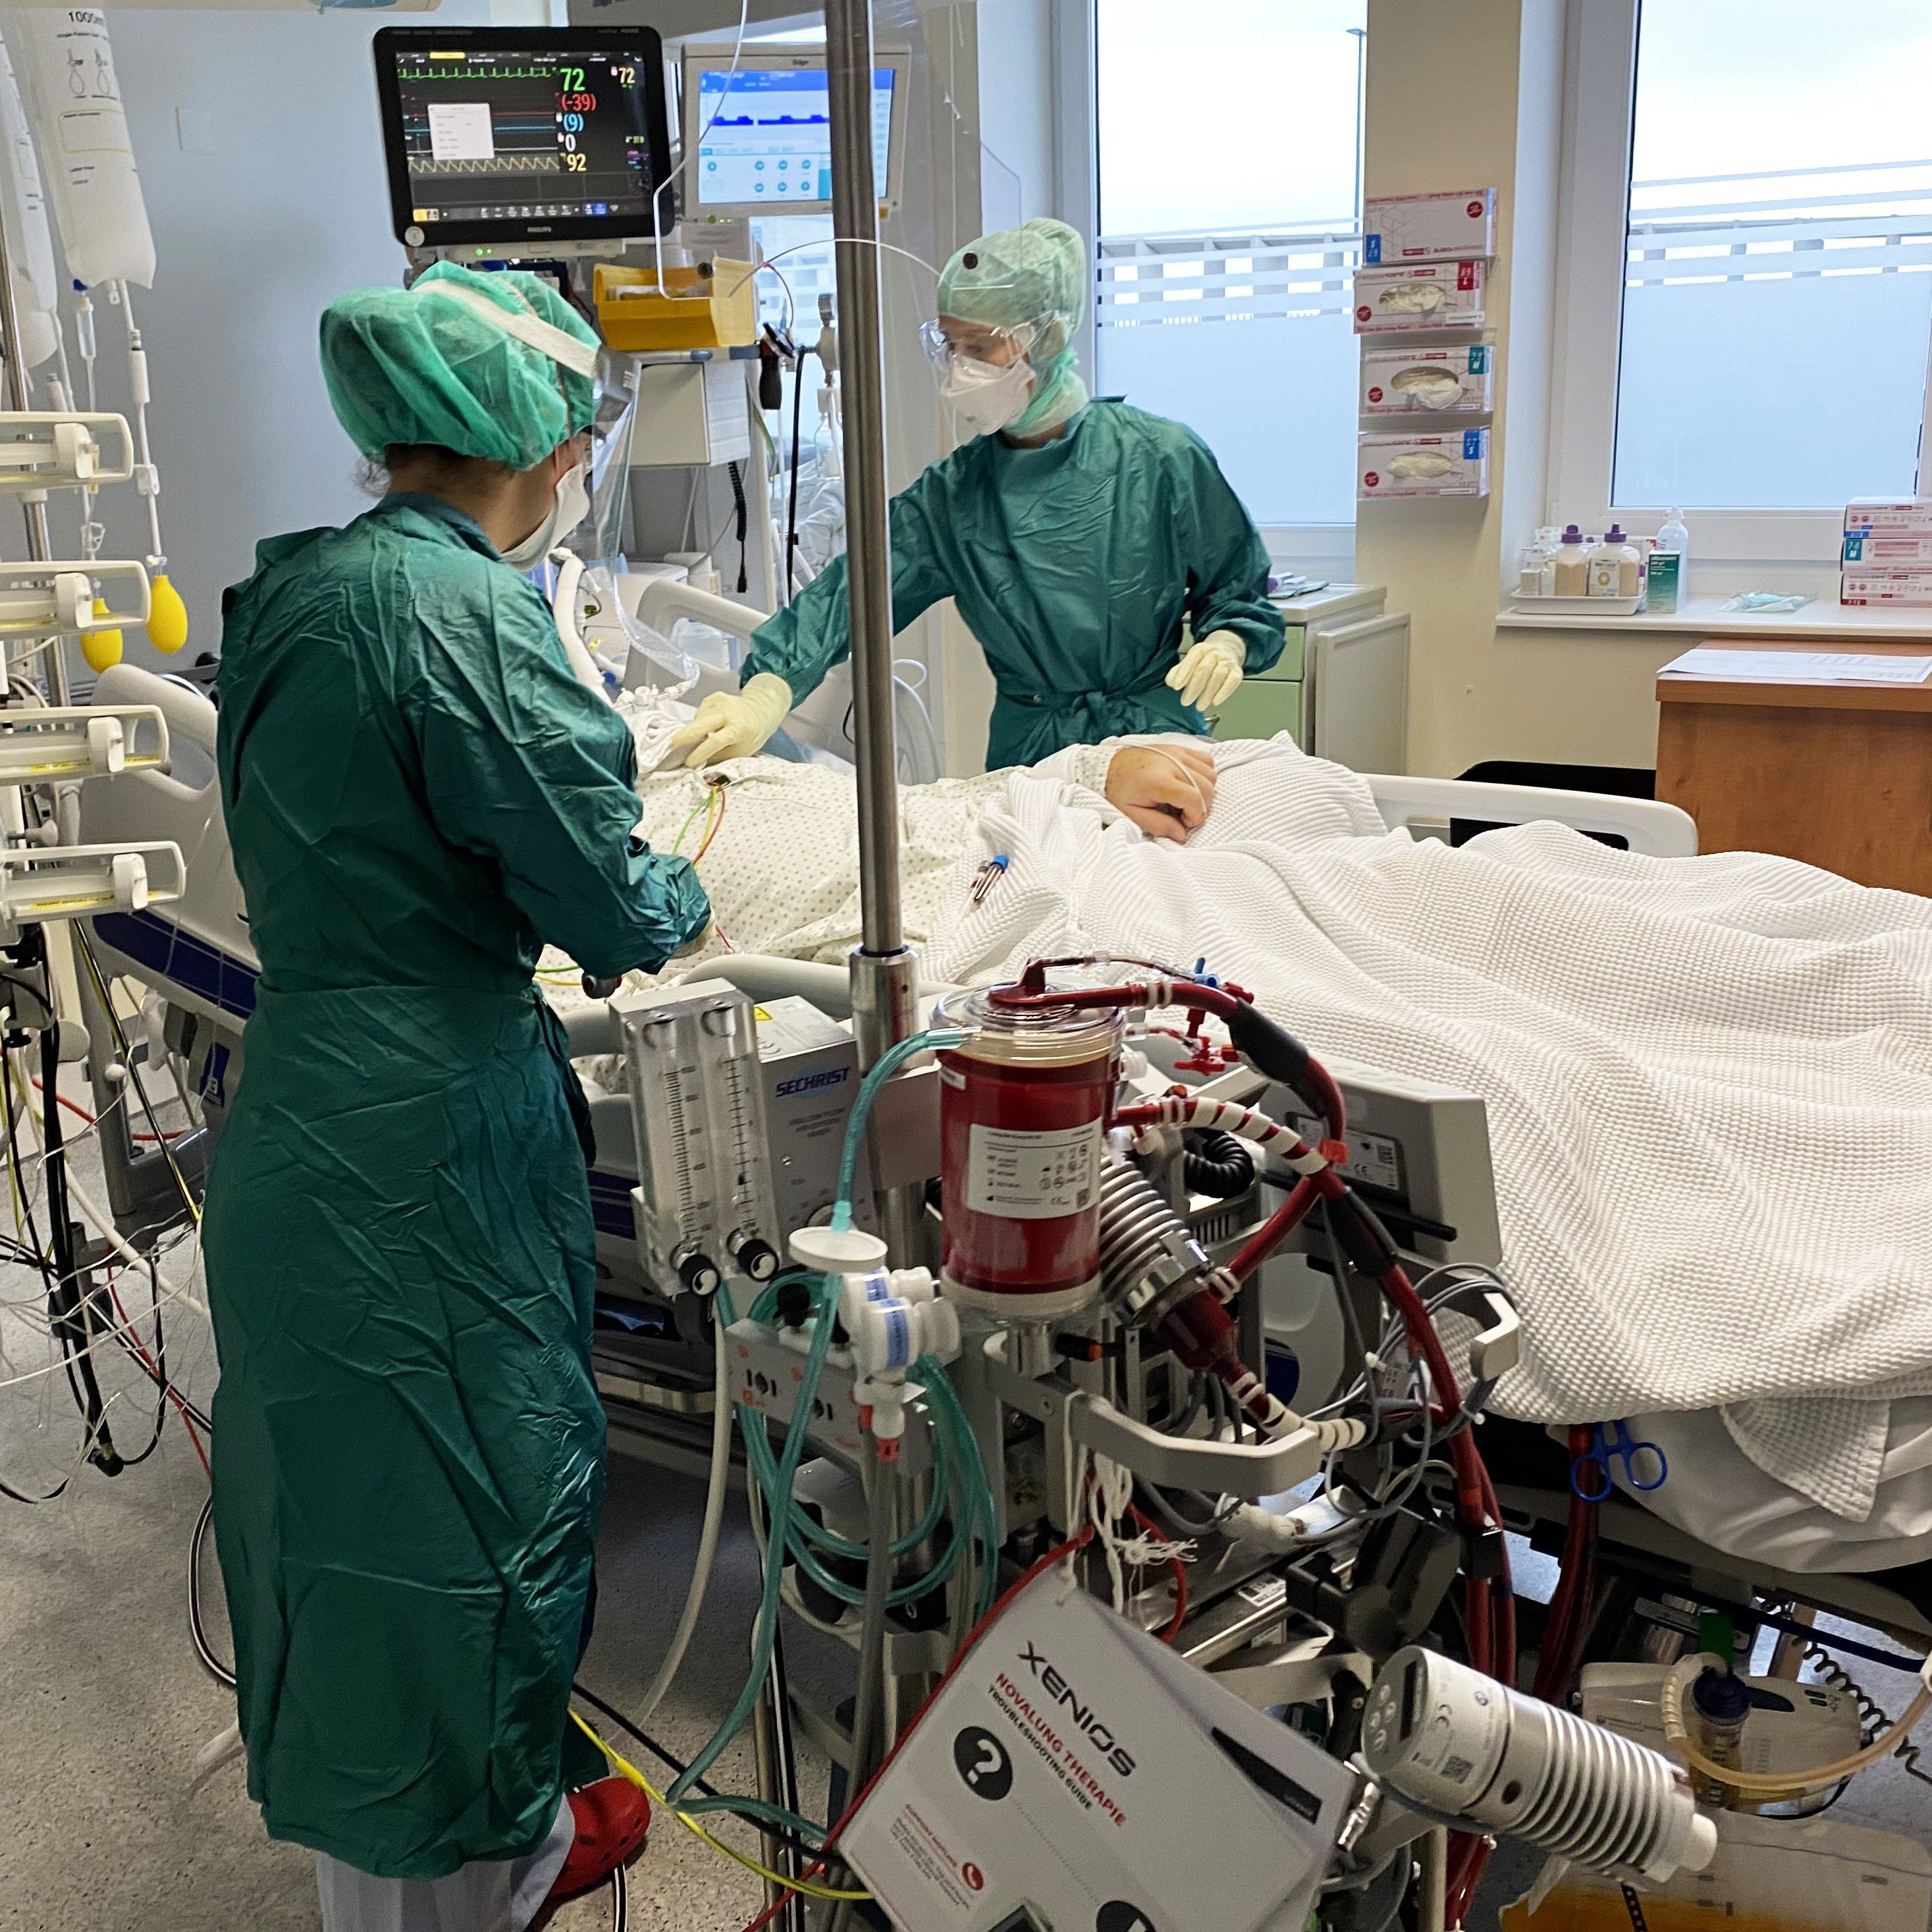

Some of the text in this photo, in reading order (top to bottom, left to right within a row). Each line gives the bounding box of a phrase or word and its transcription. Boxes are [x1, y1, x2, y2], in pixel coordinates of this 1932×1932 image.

[560, 67, 635, 92] 72 72
[561, 94, 597, 111] (-39)
[563, 113, 584, 132] (9)
[565, 134, 576, 151] 0
[566, 153, 587, 172] 92
[776, 1067, 851, 1097] SECHRIST
[1017, 1640, 1137, 1777] XENIOS
[988, 1684, 1092, 1810] TROUBLESHOOTING GUIDE
[996, 1673, 1127, 1827] NOVALUNG THERAPIE
